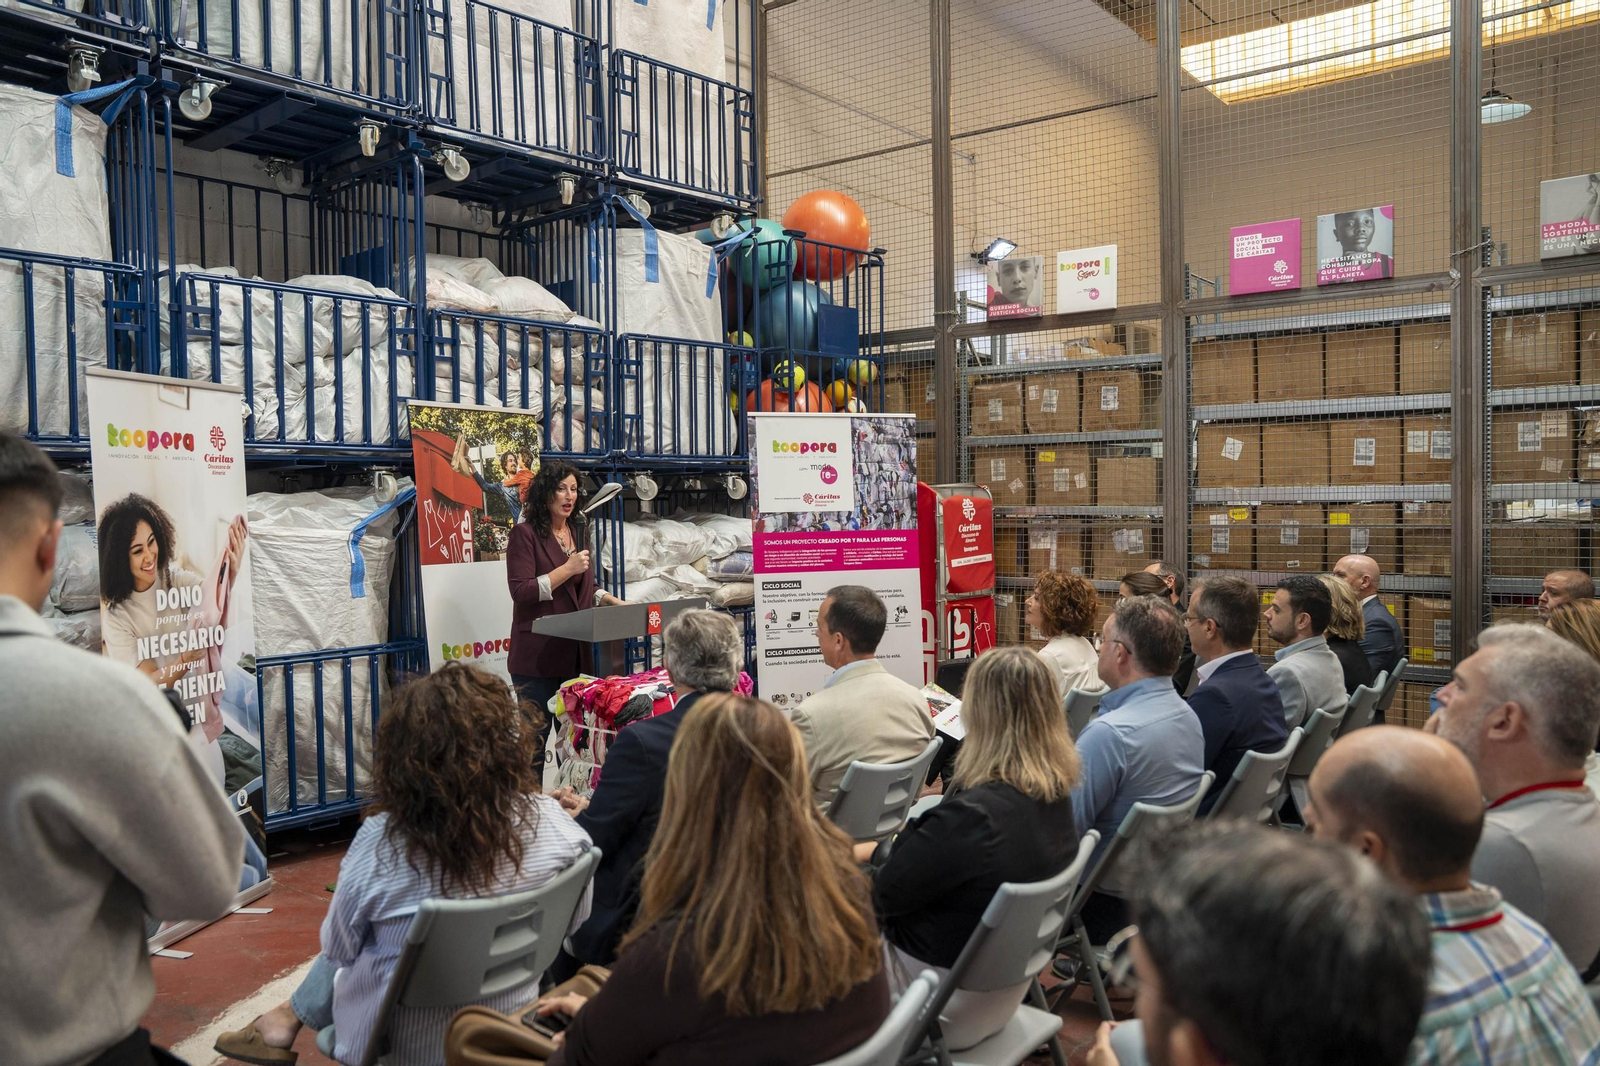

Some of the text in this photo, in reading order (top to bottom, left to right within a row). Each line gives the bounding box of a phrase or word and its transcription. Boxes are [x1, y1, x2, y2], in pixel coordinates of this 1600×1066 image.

[1560, 221, 1587, 229] MODA
[1544, 225, 1600, 238] SOSTENIBLE
[1247, 237, 1281, 245] PROYECTO
[1247, 248, 1274, 256] CÁRITAS
[1321, 253, 1371, 263] NECESITAMOS
[1321, 261, 1359, 269] CONSUMIR
[1077, 269, 1099, 281] Store
[107, 422, 195, 453] koopera
[772, 440, 837, 454] koopera
[204, 453, 234, 464] Cáritas
[958, 524, 981, 532] Cáritas
[156, 585, 203, 611] DONO
[194, 611, 204, 619] es
[137, 625, 225, 660] NECESARIO
[160, 659, 205, 679] y porque
[173, 670, 226, 700] SIENTA
[189, 701, 206, 725] EN
